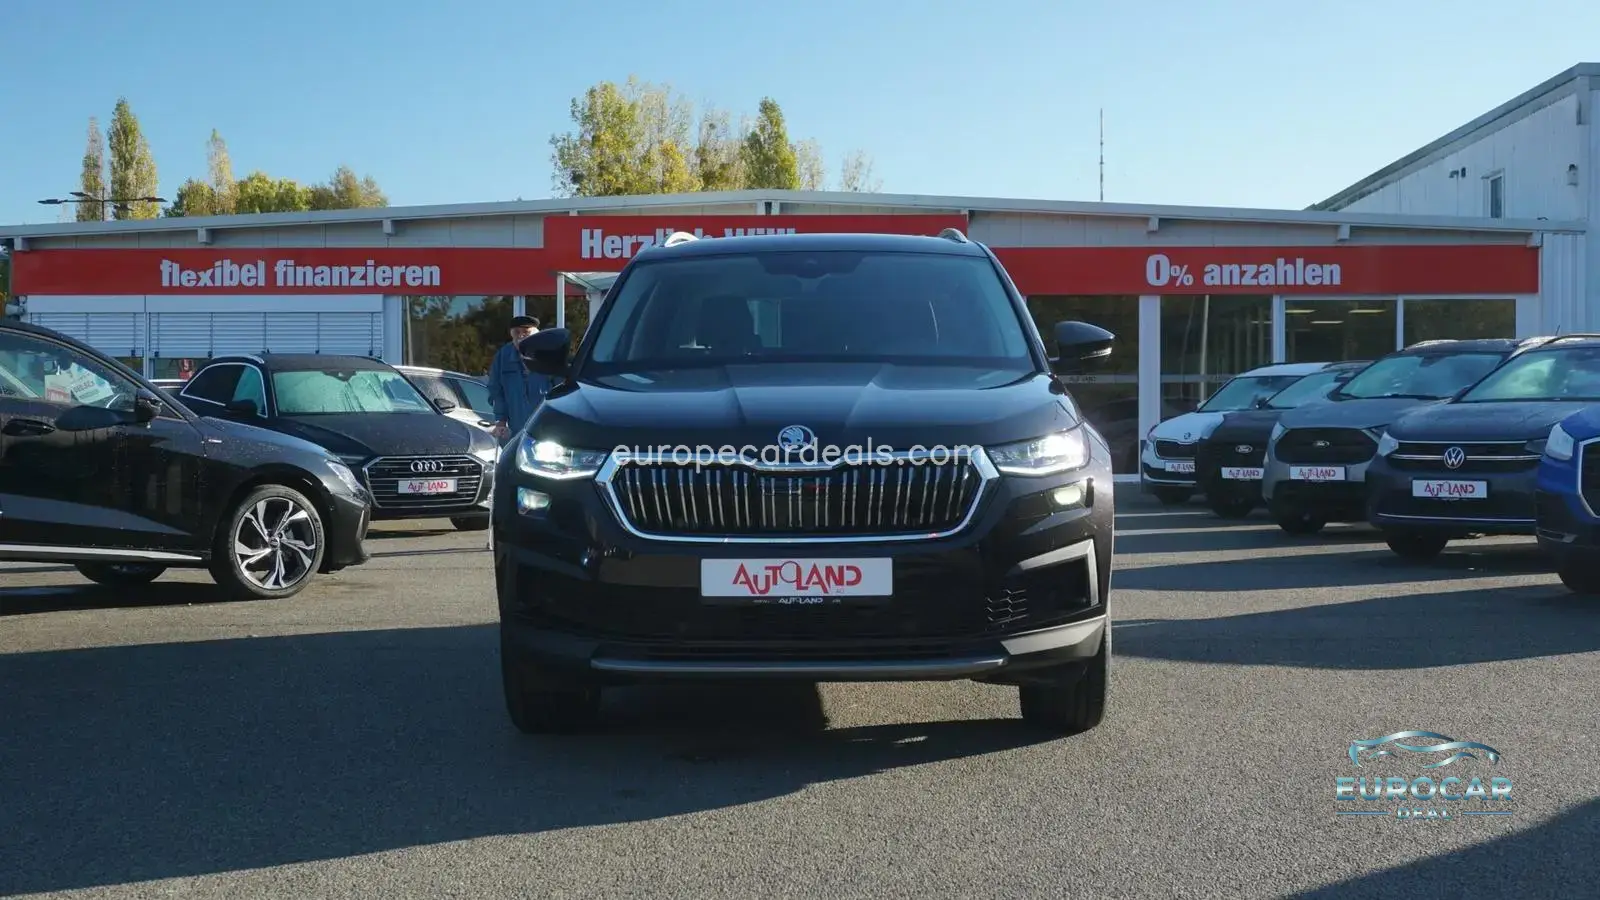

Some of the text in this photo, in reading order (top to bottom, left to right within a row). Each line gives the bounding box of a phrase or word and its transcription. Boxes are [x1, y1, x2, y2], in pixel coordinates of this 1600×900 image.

[581, 228, 712, 258] Herzl
[160, 259, 441, 287] flexibel finanzieren
[1146, 254, 1341, 287] 0% anzahlen
[732, 560, 863, 595] AUTOLAND
